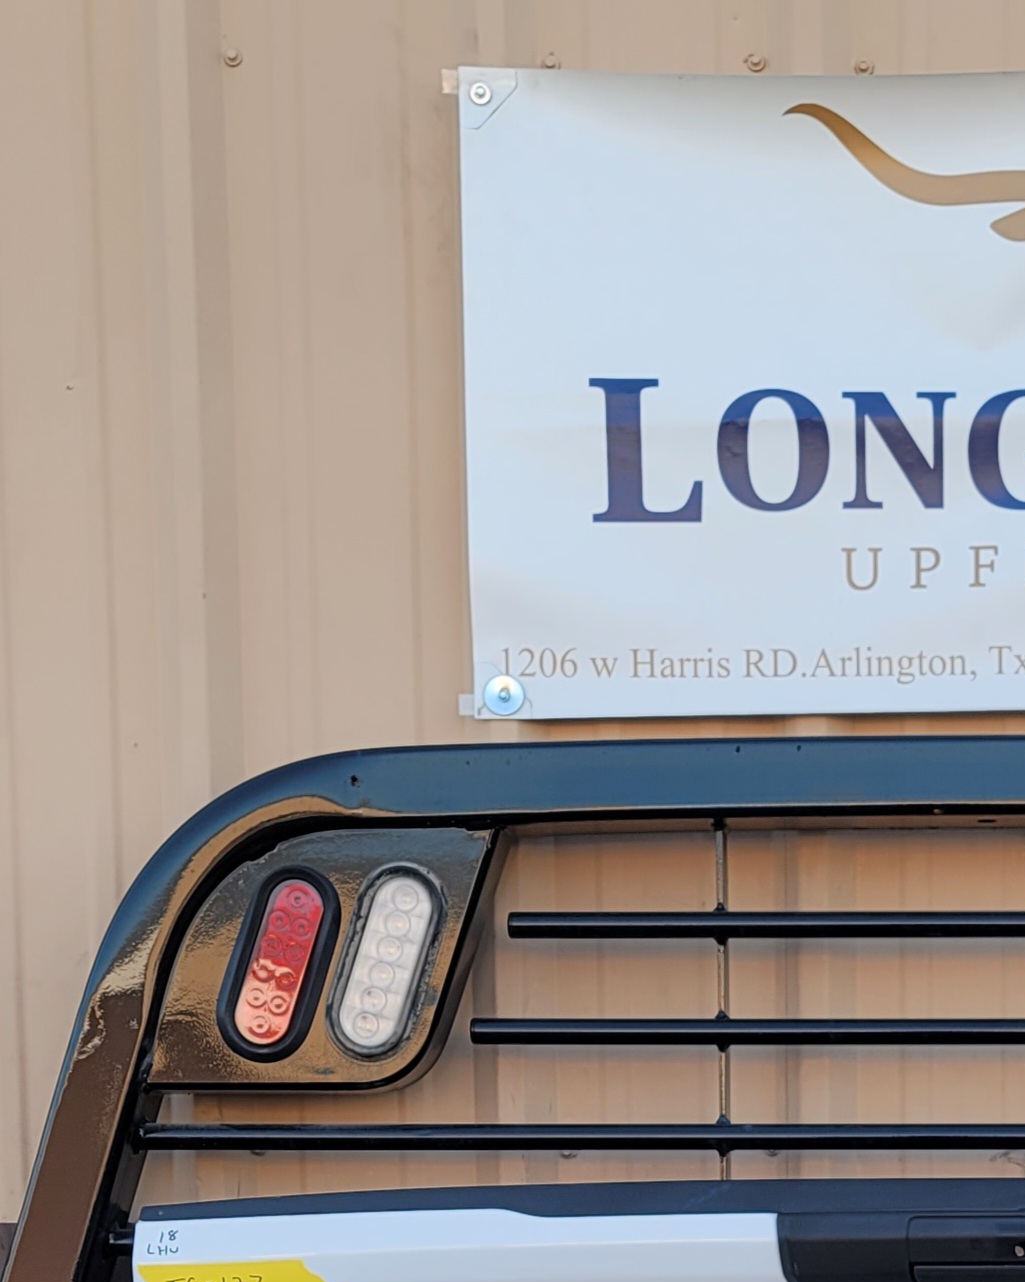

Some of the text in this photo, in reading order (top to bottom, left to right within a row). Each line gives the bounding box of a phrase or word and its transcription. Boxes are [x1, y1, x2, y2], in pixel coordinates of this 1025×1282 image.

[501, 647, 578, 678] 1206
[589, 657, 618, 679] w
[629, 647, 731, 679] Harris
[159, 1229, 179, 1243] 18
